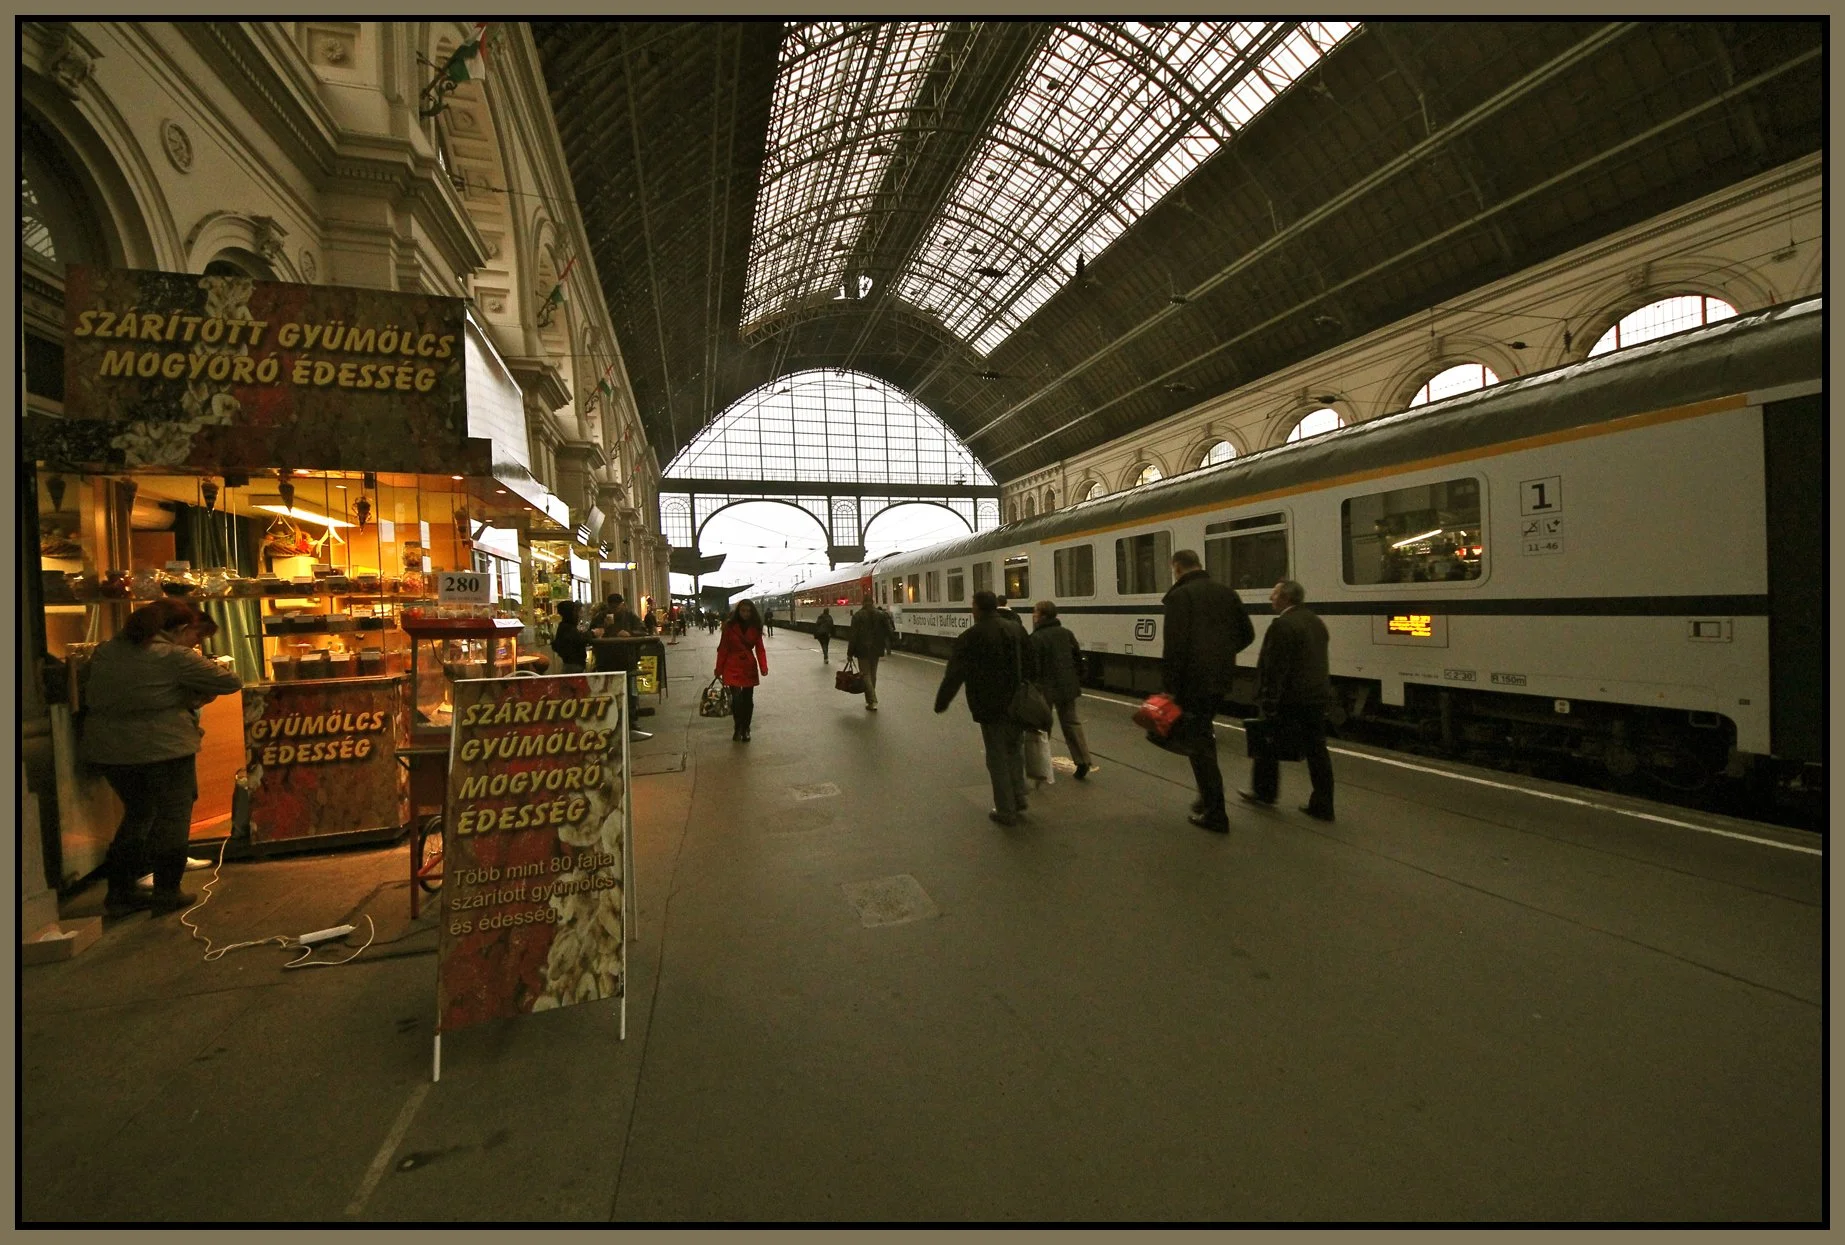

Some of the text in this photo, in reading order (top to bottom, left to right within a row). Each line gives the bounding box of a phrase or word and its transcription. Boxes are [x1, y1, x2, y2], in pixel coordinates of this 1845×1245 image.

[73, 306, 269, 346] SZÁRÍTOTT
[291, 353, 438, 393] ÉDESSÉG
[1531, 483, 1553, 510] 1
[1528, 542, 1559, 552] 11-46
[445, 576, 480, 593] 280
[958, 617, 969, 628] car
[251, 709, 388, 740] GYÜMÖLCS,
[461, 695, 612, 727] SZÁRÍTOTT
[262, 735, 372, 766] ÉDESSÉG
[460, 727, 615, 762] GYÜMÖLCS,
[457, 794, 588, 835] ÉDESSÉG
[453, 852, 614, 887] Több mint 80 fajta
[451, 884, 527, 911] szárított
[450, 919, 473, 936] és
